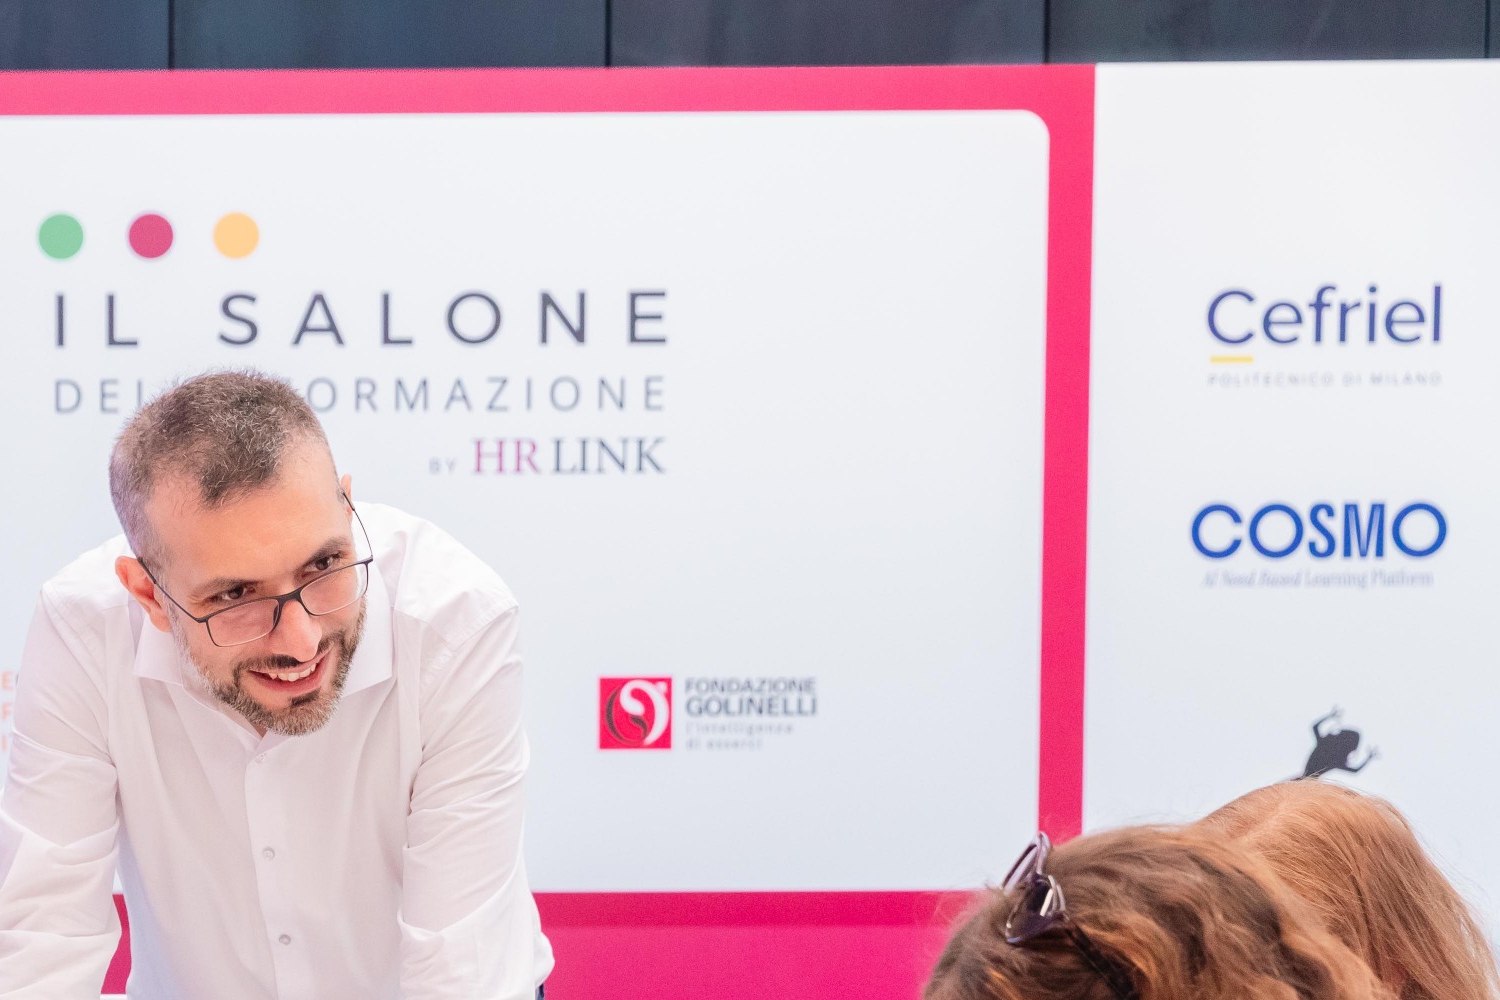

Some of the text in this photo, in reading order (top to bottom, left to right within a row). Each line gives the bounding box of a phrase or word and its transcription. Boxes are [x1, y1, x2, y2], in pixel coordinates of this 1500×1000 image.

[55, 290, 668, 349] IL SALONE
[1206, 283, 1443, 345] Cefriel
[304, 374, 666, 414] ORMAZIONE
[428, 435, 667, 477] BY HR LINK
[1191, 501, 1448, 560] COSMO
[684, 676, 820, 718] FONDAZIONE GOLINELLI
